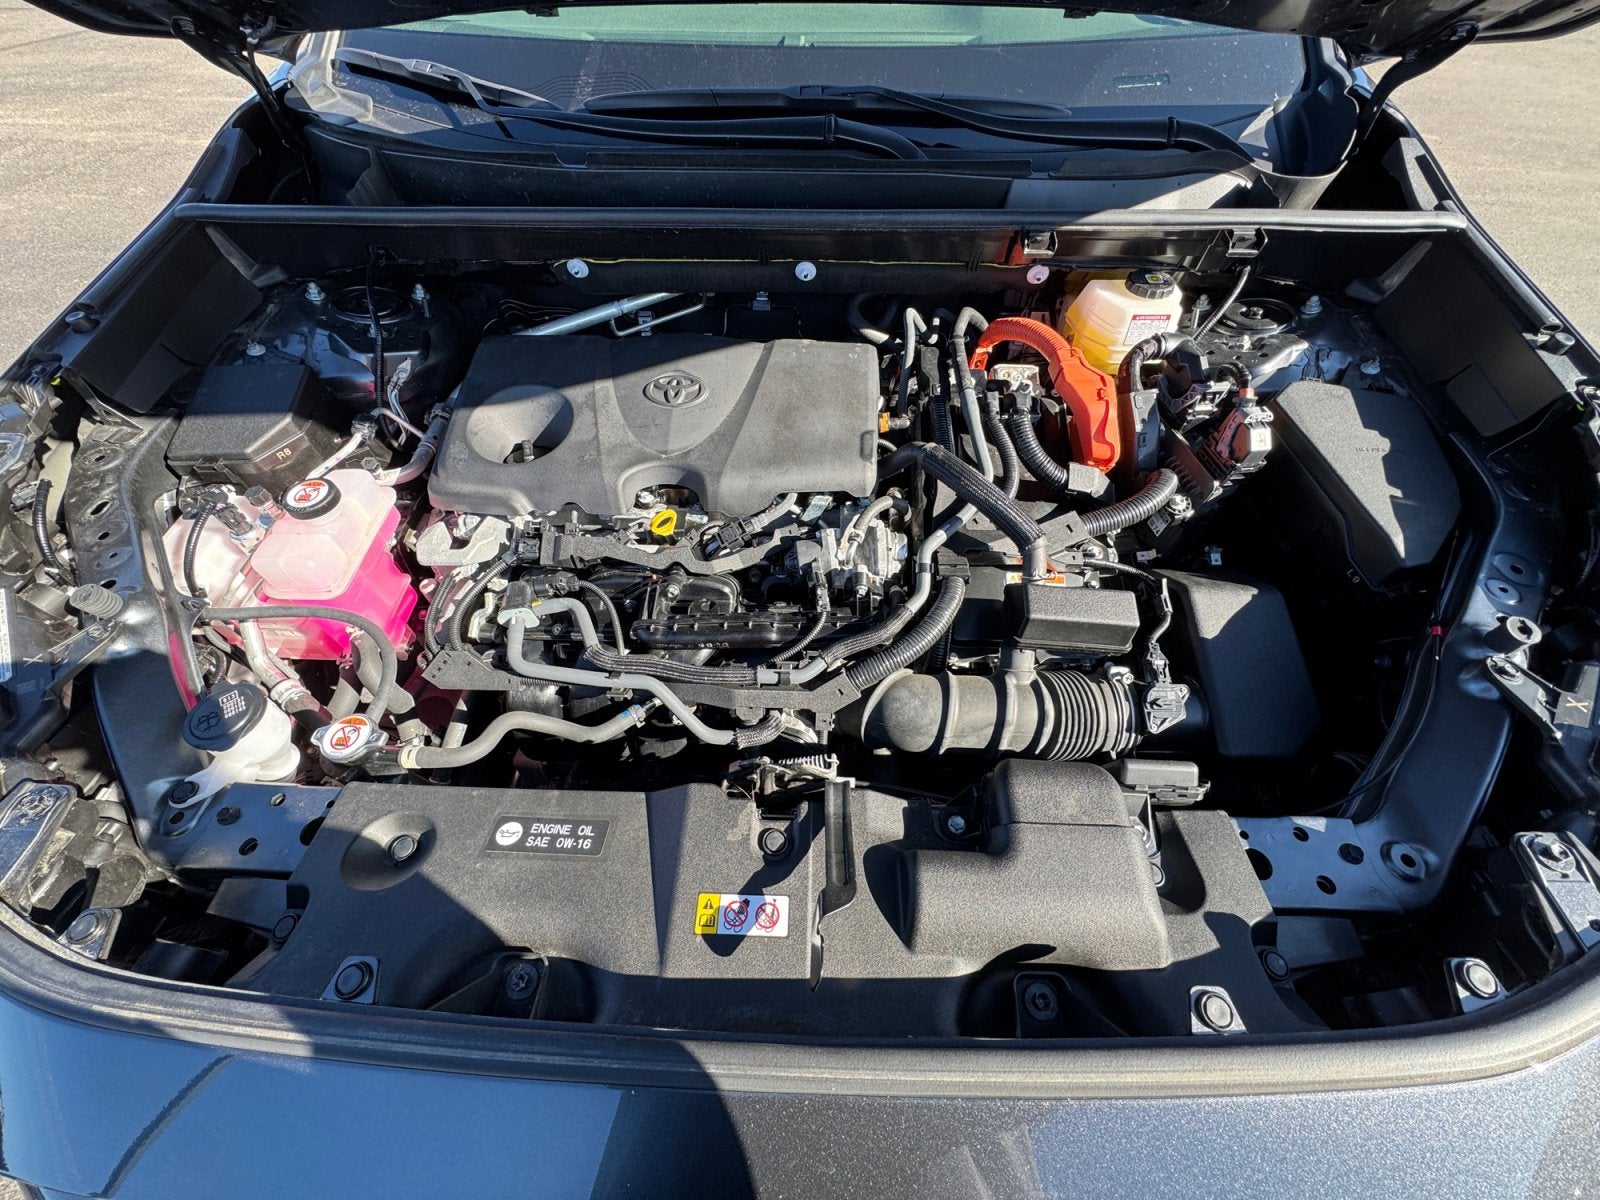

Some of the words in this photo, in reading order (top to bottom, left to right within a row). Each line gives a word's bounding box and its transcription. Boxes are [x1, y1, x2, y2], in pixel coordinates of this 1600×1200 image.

[276, 447, 292, 460] R8
[530, 823, 572, 835] ENGINE
[577, 825, 595, 836] OIL
[525, 836, 551, 847] SAE
[555, 837, 592, 849] 0W-16
